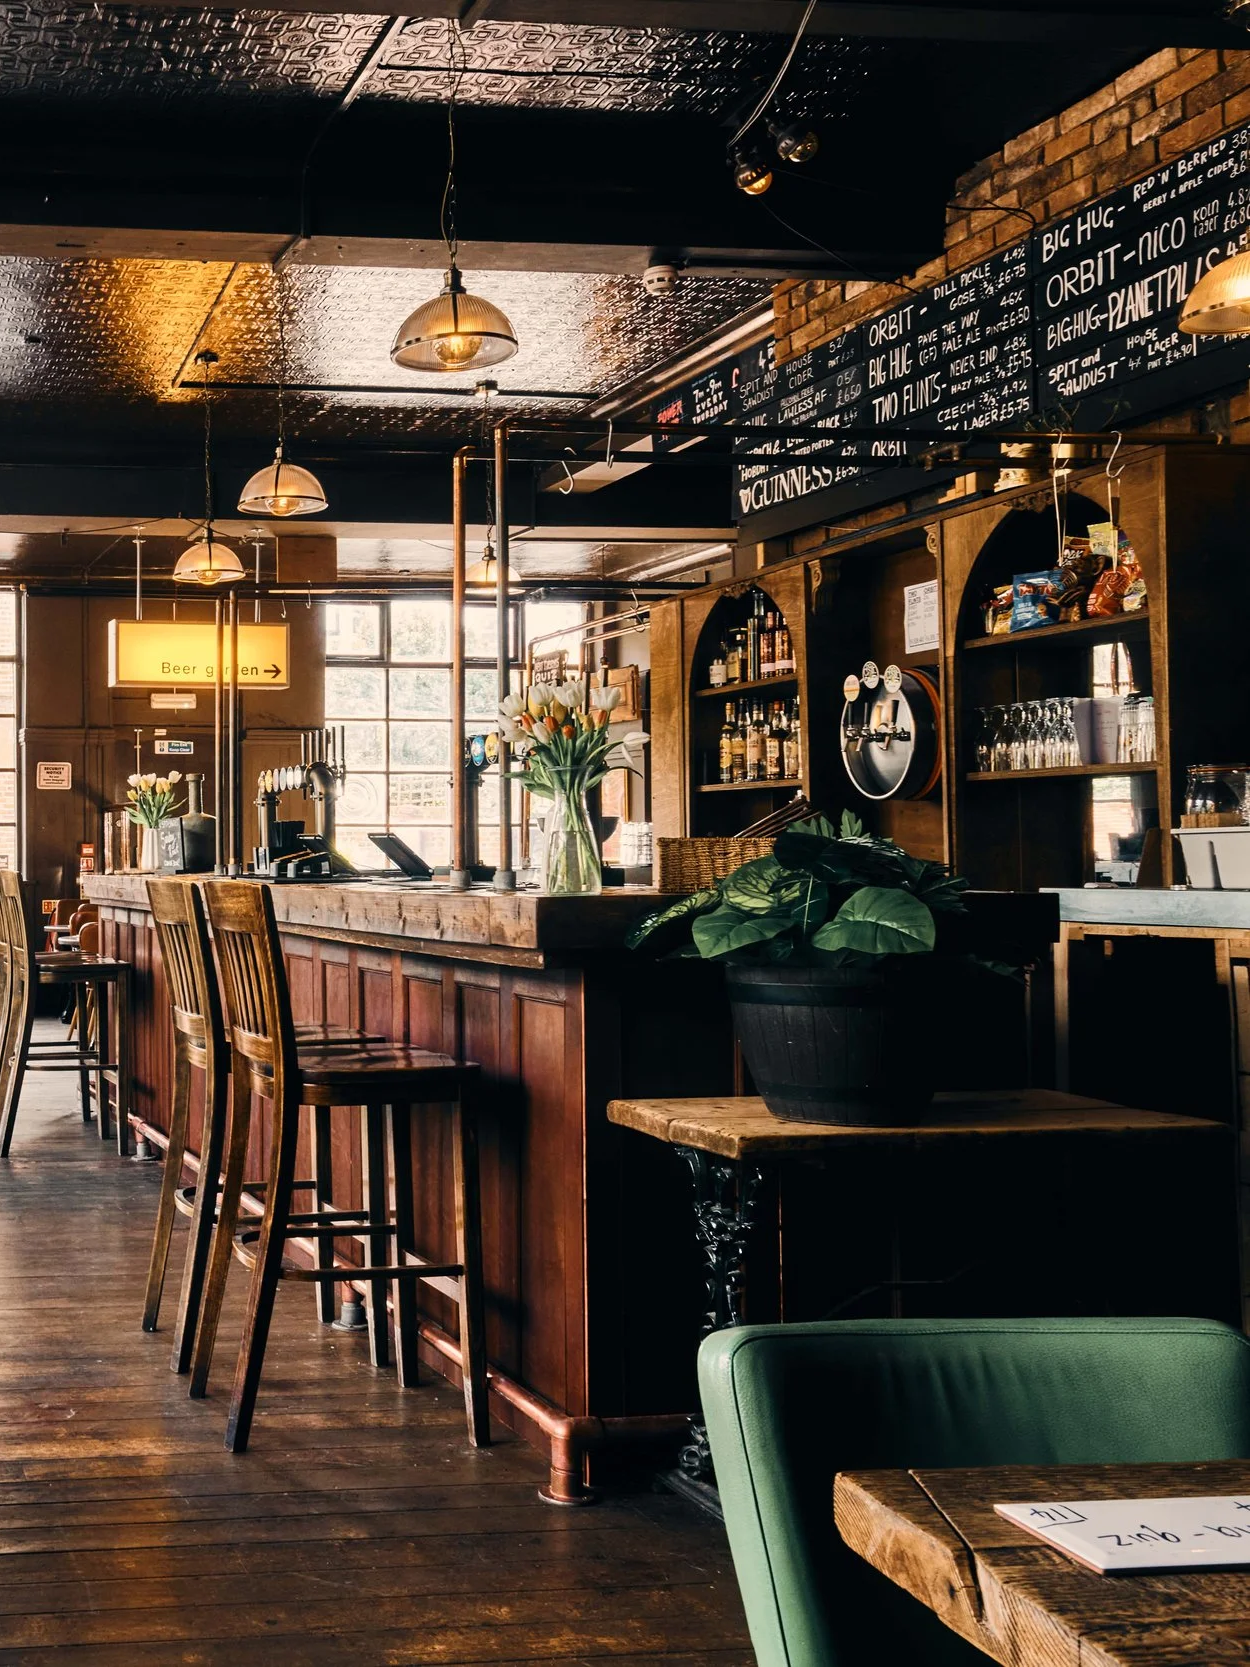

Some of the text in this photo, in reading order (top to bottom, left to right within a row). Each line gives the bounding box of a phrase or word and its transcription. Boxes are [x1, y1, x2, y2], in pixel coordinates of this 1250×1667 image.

[1133, 177, 1155, 202] RED
[1178, 139, 1227, 178] BERRIED
[1143, 192, 1167, 212] BERRY
[1178, 175, 1203, 195] APPLE
[1207, 158, 1234, 178] CIDER
[1043, 224, 1070, 263] BIG
[1077, 206, 1114, 245] HUG
[933, 284, 957, 300] DILL
[960, 263, 991, 288] PICKLE
[950, 288, 976, 311] GOSE
[869, 305, 914, 347] ORBIT
[918, 329, 938, 347] PAVE
[942, 320, 956, 336] THE
[961, 309, 980, 330] WAY
[942, 334, 962, 355] PALE
[965, 327, 981, 345] ALE
[1127, 327, 1158, 350] HOUSE
[1148, 332, 1179, 356] LAGER
[786, 352, 813, 375] HOUSE
[869, 354, 886, 389] BIG
[889, 342, 913, 381] HUG
[950, 354, 975, 378] NEVER
[979, 345, 998, 367] END
[1049, 347, 1100, 385] SPIT and
[739, 377, 760, 399] SPIT
[762, 369, 778, 384] AND
[788, 367, 814, 389] CIDER
[951, 378, 972, 395] HAZY
[974, 371, 991, 386] PALE
[1057, 361, 1118, 396] SAWDUST
[692, 400, 728, 424] THURSDAY
[695, 391, 723, 414] EVERY
[742, 386, 775, 412] SAWDUST
[778, 397, 813, 424] LAWLESS
[815, 388, 827, 405] AF
[872, 391, 898, 424] TWO
[937, 400, 975, 423] CZECH
[964, 408, 998, 431] LAGER
[751, 465, 833, 510] GUINNESS
[161, 662, 259, 678] Beer gren
